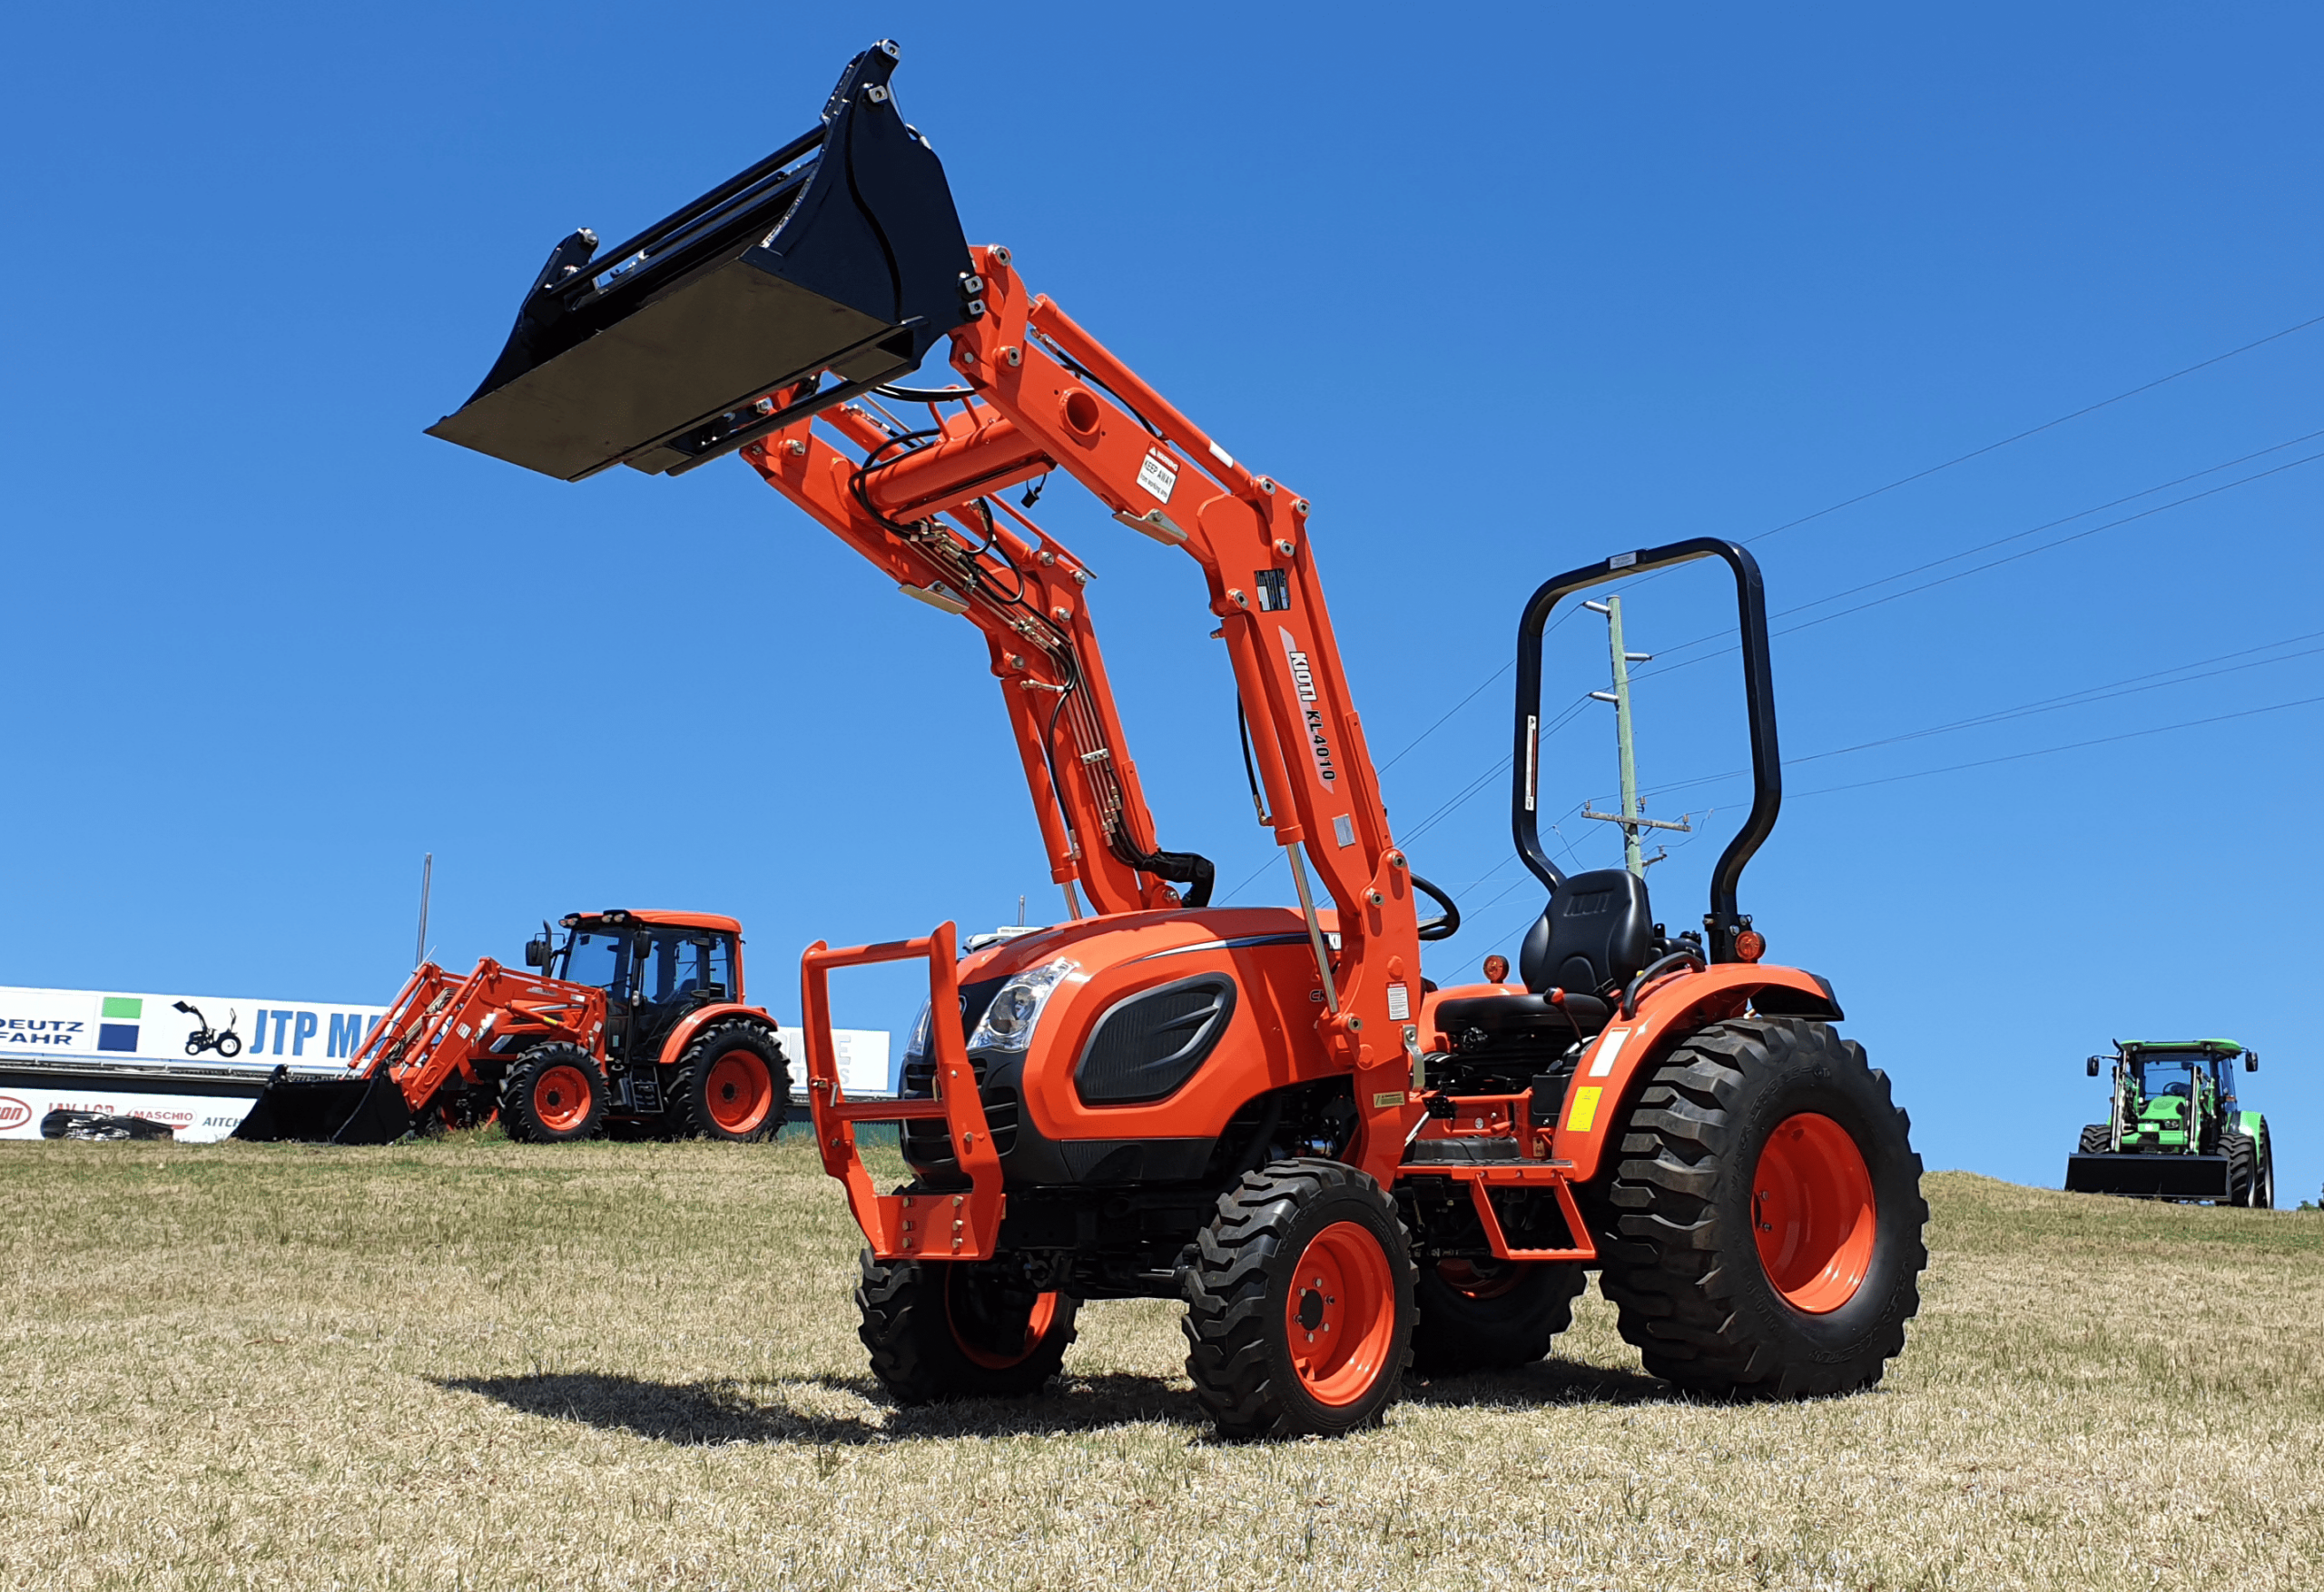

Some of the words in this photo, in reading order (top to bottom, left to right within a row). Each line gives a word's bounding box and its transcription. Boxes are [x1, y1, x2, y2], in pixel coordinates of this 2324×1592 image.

[1144, 459, 1158, 475] KEEP
[1157, 469, 1173, 487] AWAY
[1289, 652, 1317, 702] KIOTI
[1305, 710, 1336, 781] KL4010
[249, 1008, 318, 1056] JTP
[133, 1110, 193, 1121] MASCHIO
[202, 1116, 243, 1127] AITCH
